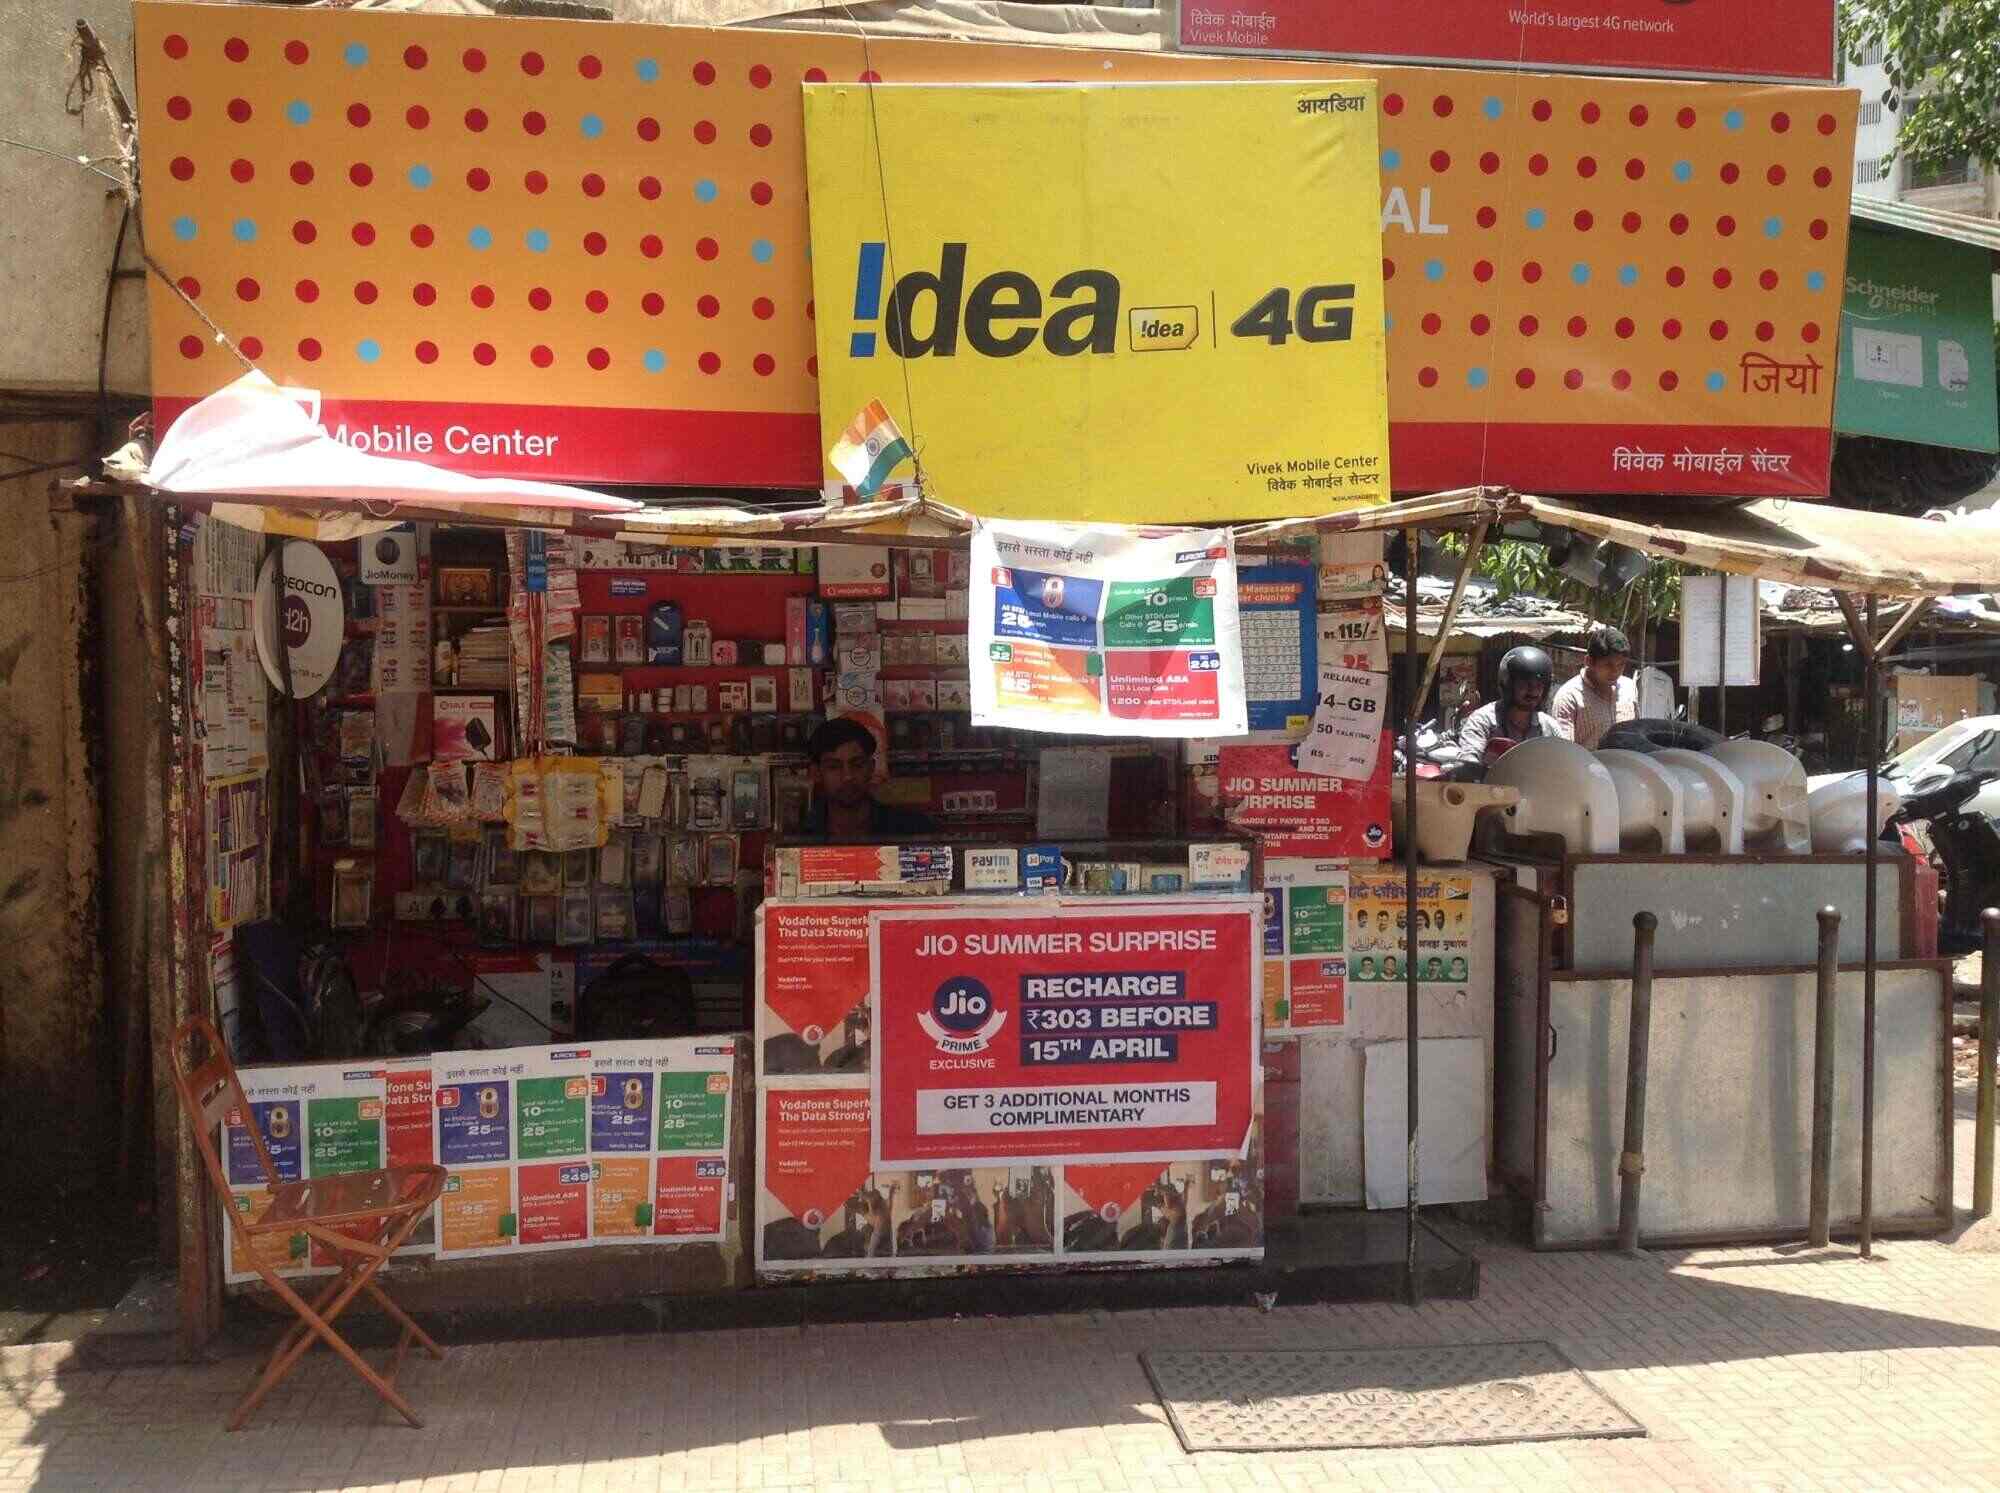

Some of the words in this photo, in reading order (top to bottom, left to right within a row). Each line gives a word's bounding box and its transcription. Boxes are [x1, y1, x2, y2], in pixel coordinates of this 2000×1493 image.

[1191, 8, 1225, 27] विवेक
[1231, 10, 1276, 31] मोबाईल
[1508, 9, 1555, 26] World's
[1557, 13, 1600, 31] largest
[1602, 15, 1621, 30] 4G
[1623, 17, 1674, 33] network
[1190, 29, 1224, 43] Vivek
[1226, 30, 1270, 46] Mobile
[1297, 92, 1366, 114] आयडिया
[1846, 276, 1940, 304] Schneider
[1230, 284, 1355, 345] 4G
[1740, 352, 1823, 394] जियो
[319, 424, 434, 454] Mobile
[444, 425, 559, 457] Center
[1247, 462, 1282, 475] Vivek
[1287, 459, 1330, 472] Mobile
[1334, 456, 1379, 469] Center
[1613, 446, 1665, 472] विवेक
[1673, 446, 1744, 475] मोबाईल
[1751, 447, 1792, 473] सेंटर
[1268, 478, 1297, 492] विवेक
[1302, 474, 1343, 489] मोबाईल
[1146, 619, 1179, 633] 25
[1191, 659, 1220, 670] 249
[1110, 674, 1163, 685] Unlimited
[1323, 672, 1372, 687] RELIANCE
[1316, 723, 1334, 735] 50
[1225, 777, 1254, 792] JIO
[1260, 777, 1344, 793] SUMMER
[1243, 795, 1317, 810] RPRISE
[778, 916, 830, 926] Vodafone
[778, 928, 798, 937] The
[800, 928, 825, 937] Data
[826, 928, 864, 940] Strong
[915, 935, 959, 956] JIO
[964, 933, 1083, 955] SUMMER
[1089, 930, 1217, 953] SURPRISE
[1027, 975, 1177, 999] RECHARGE
[940, 990, 987, 1015] Jio
[1026, 1008, 1093, 1030] ₹303
[1101, 1005, 1210, 1028] BEFORE
[941, 1038, 983, 1052] PRIME
[1029, 1039, 1082, 1061] 15TH
[1089, 1037, 1170, 1060] APRIL
[929, 1059, 997, 1071] EXCLUSIVE
[386, 1082, 415, 1092] fone
[567, 1086, 587, 1096] 22
[665, 1100, 684, 1109] 10
[779, 1099, 831, 1110] Vodafone
[943, 1094, 980, 1111] GET
[983, 1093, 995, 1108] 3
[1000, 1091, 1109, 1108] ADDITIONAL
[1113, 1088, 1191, 1105] MONTHS
[522, 1106, 542, 1117] 10
[779, 1111, 800, 1121] The
[801, 1111, 826, 1121] Data
[827, 1111, 865, 1122] Strong
[989, 1107, 1146, 1128] COMPLIMENTARY
[314, 1127, 334, 1137] 10
[467, 1124, 491, 1136] 25
[522, 1126, 546, 1137] 25
[314, 1146, 338, 1158] 25
[560, 1172, 590, 1184] 249
[697, 1167, 726, 1177] 249
